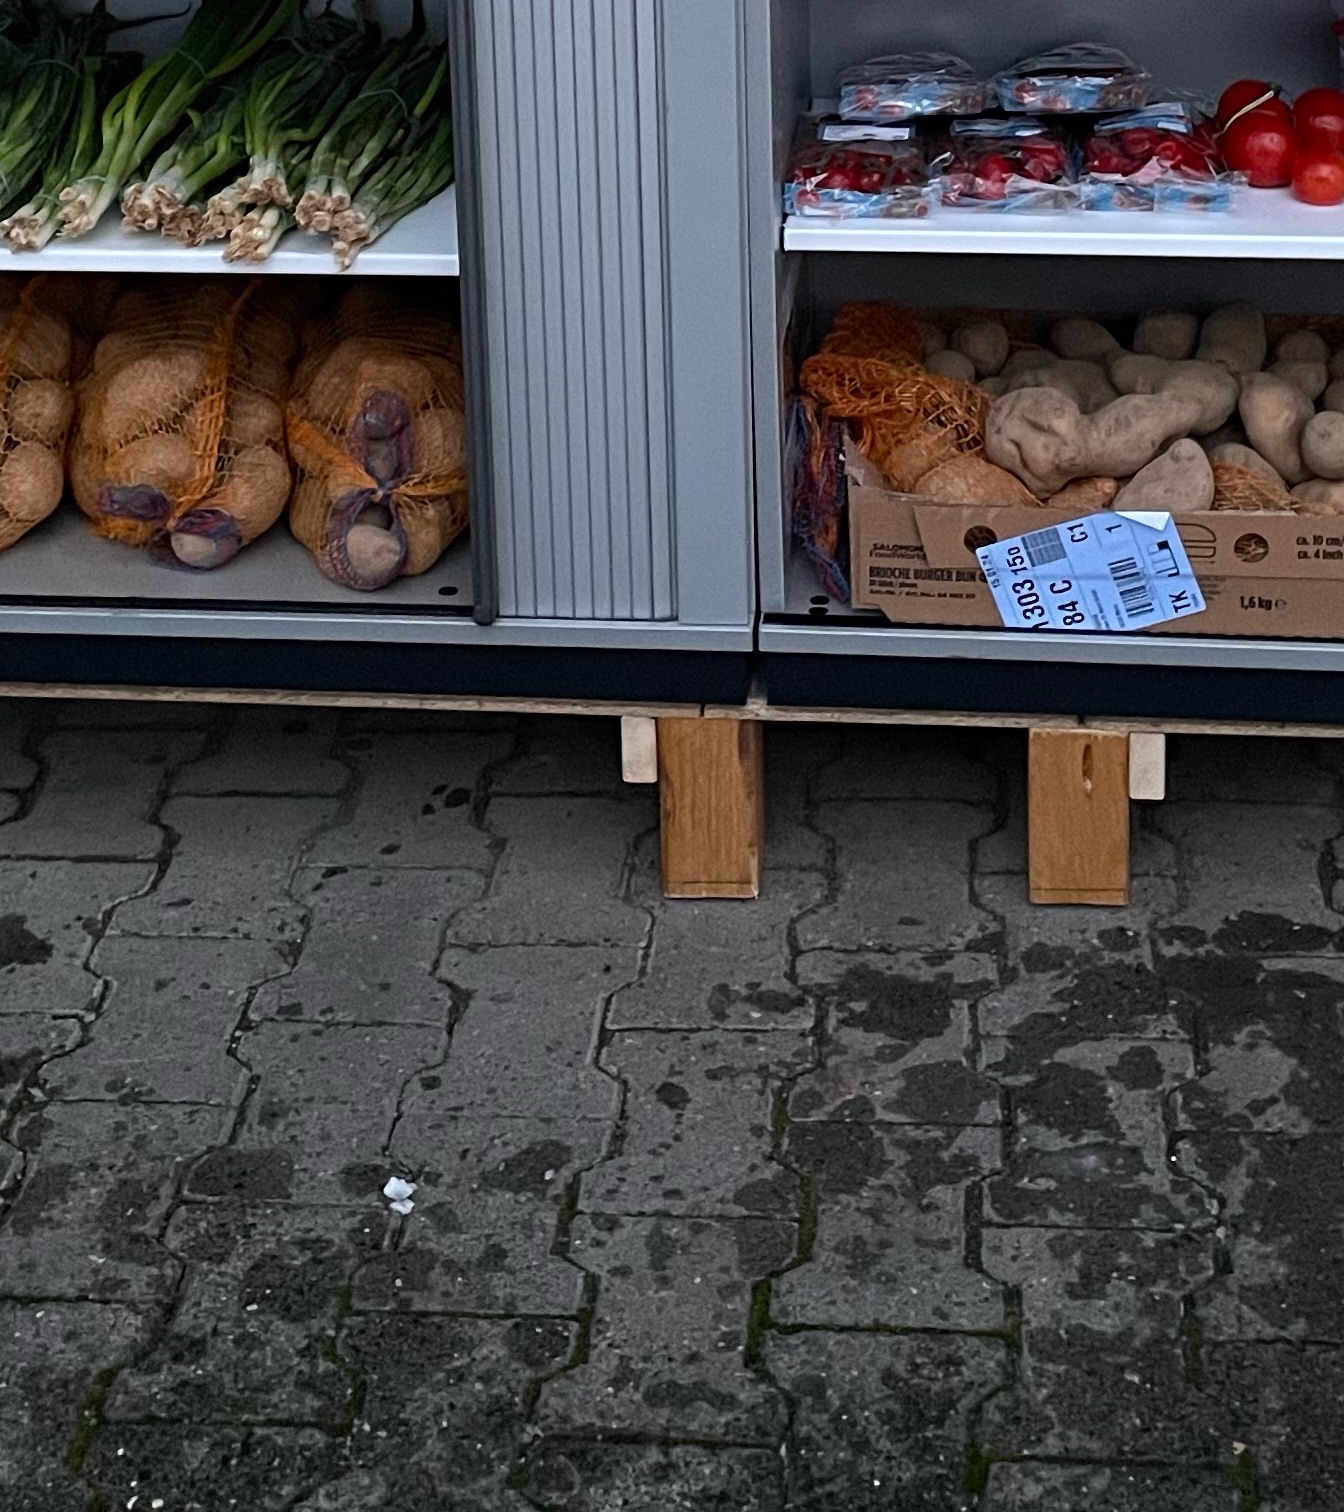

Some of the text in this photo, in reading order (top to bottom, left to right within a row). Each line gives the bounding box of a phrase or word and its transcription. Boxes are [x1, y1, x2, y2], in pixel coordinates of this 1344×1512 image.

[1066, 522, 1089, 543] C1
[1006, 546, 1028, 576] 150
[1049, 579, 1086, 627] 84 C
[1168, 589, 1193, 614] TK
